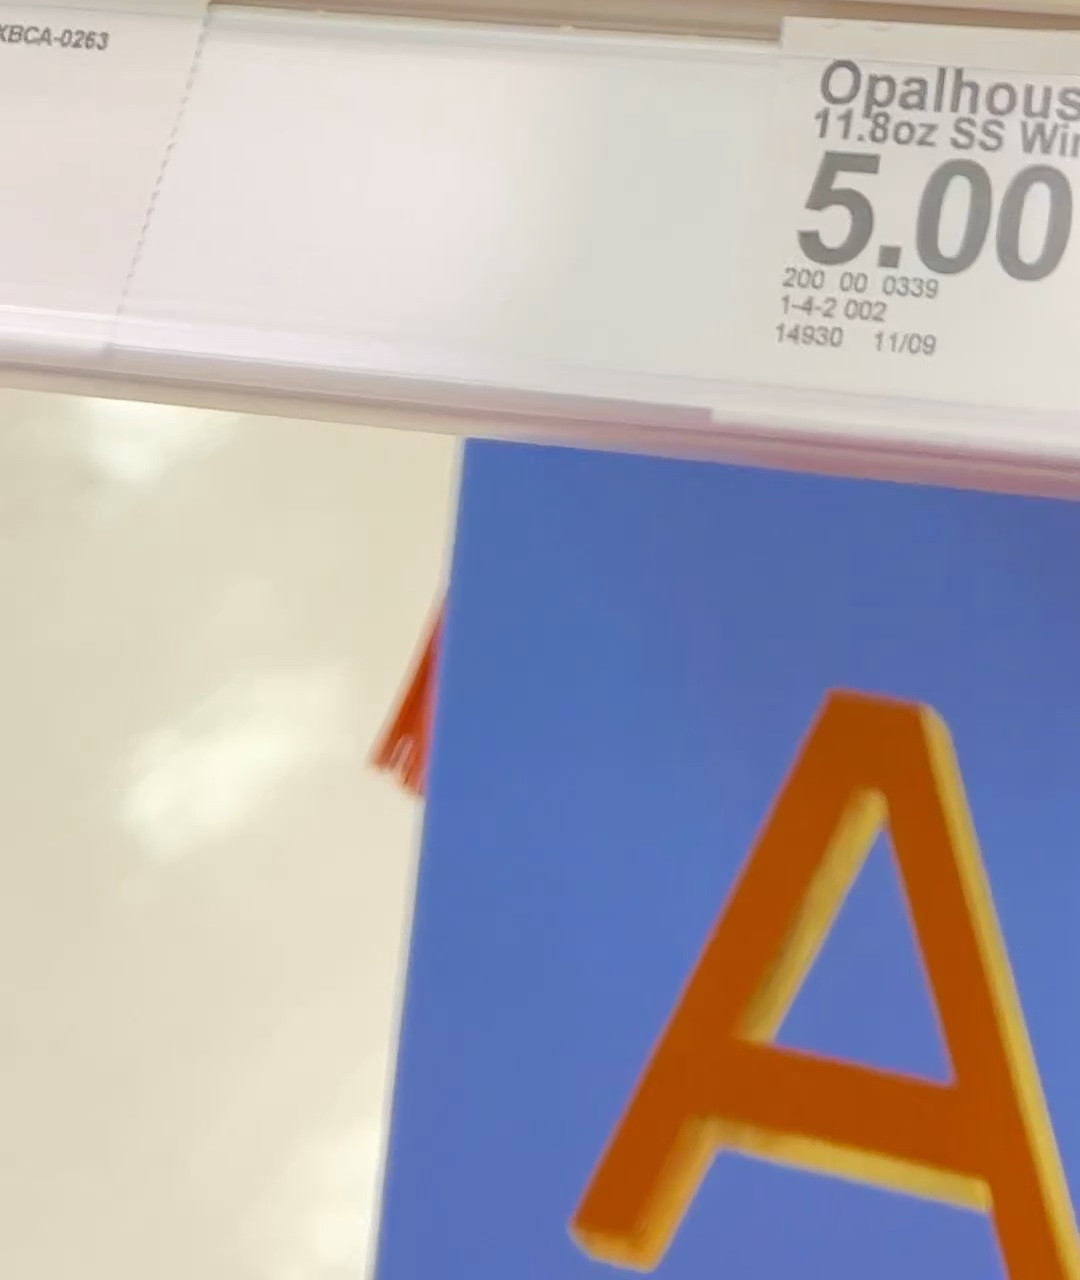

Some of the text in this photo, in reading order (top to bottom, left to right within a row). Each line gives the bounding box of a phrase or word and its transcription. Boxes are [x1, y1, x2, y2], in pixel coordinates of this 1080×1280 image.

[813, 107, 937, 147] 11.8oz
[948, 119, 1006, 153] SS
[797, 150, 1074, 282] 5.00
[782, 267, 940, 299] 200 00 0339
[781, 295, 888, 323] 1-4-2 002
[775, 323, 938, 356] 14930 11/09
